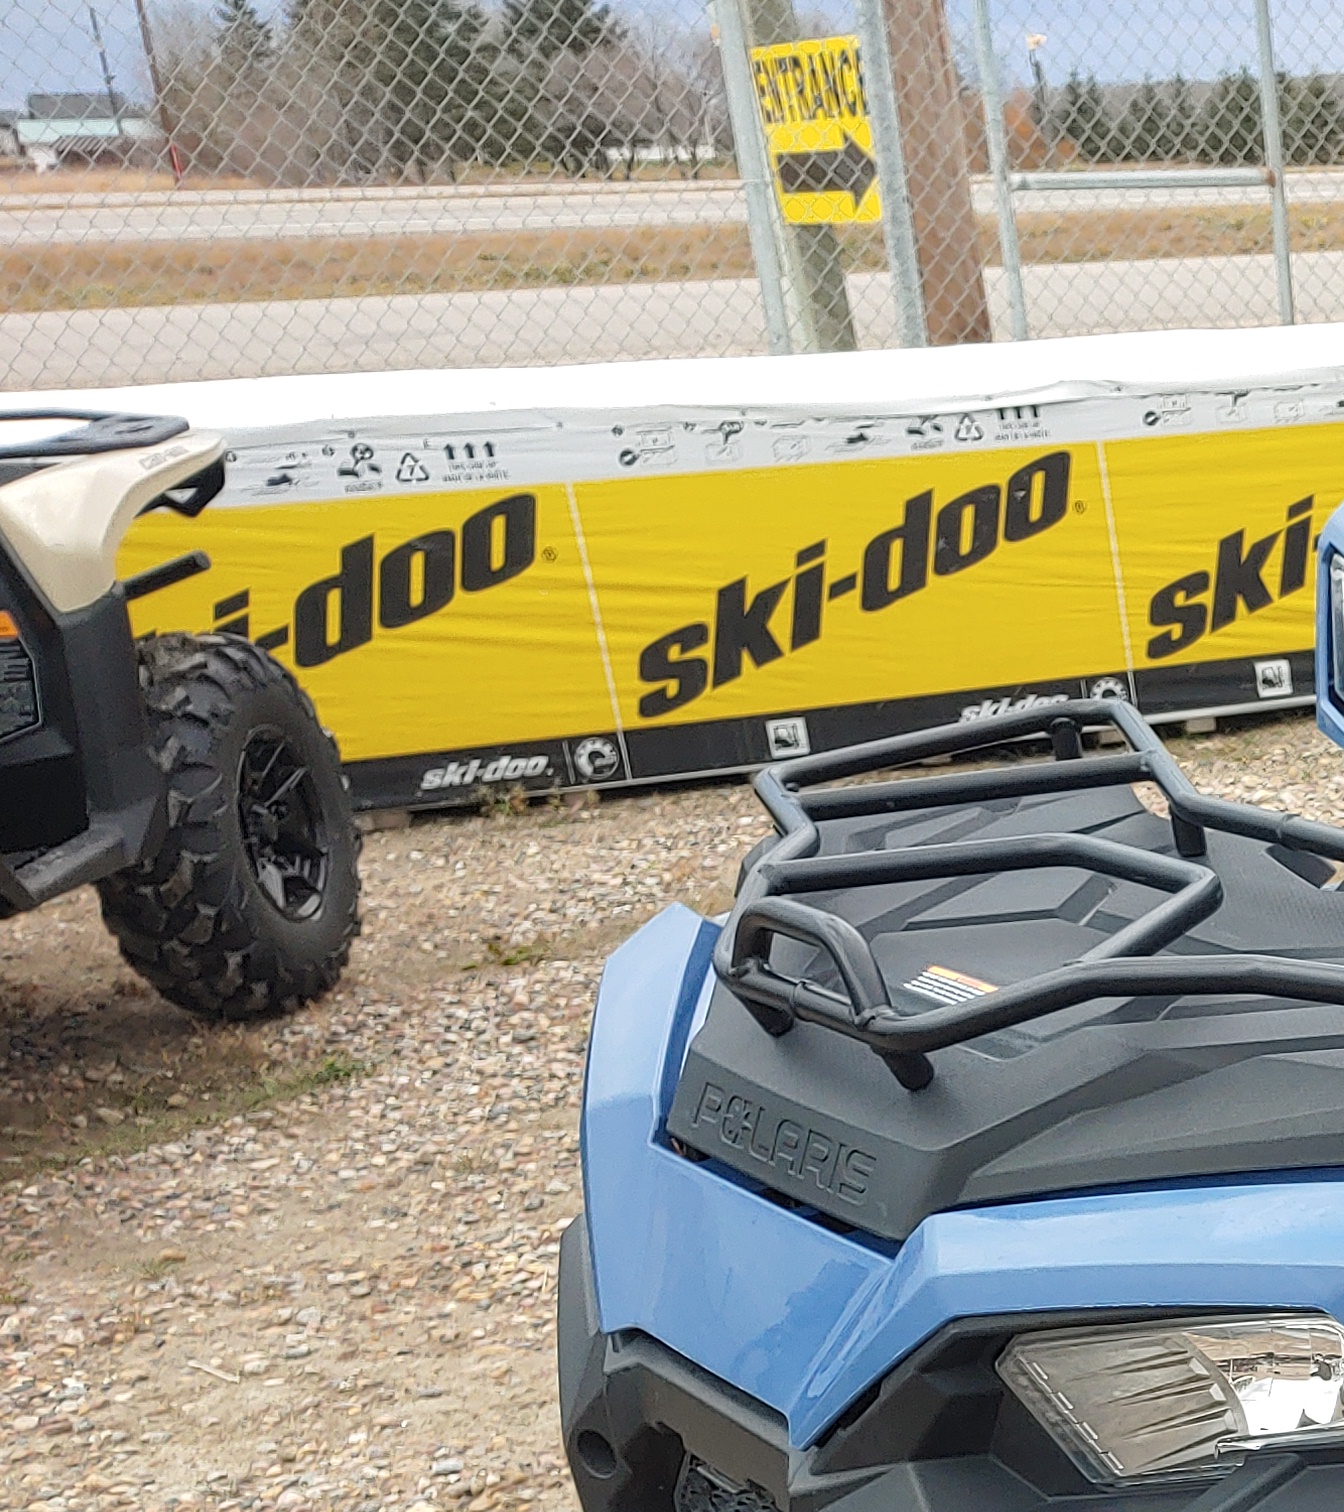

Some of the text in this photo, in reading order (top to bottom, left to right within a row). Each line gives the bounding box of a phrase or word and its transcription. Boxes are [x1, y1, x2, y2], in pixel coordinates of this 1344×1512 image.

[639, 451, 1071, 718] ski-doo
[421, 755, 549, 789] ski-doo
[692, 1081, 878, 1208] POLARIS
